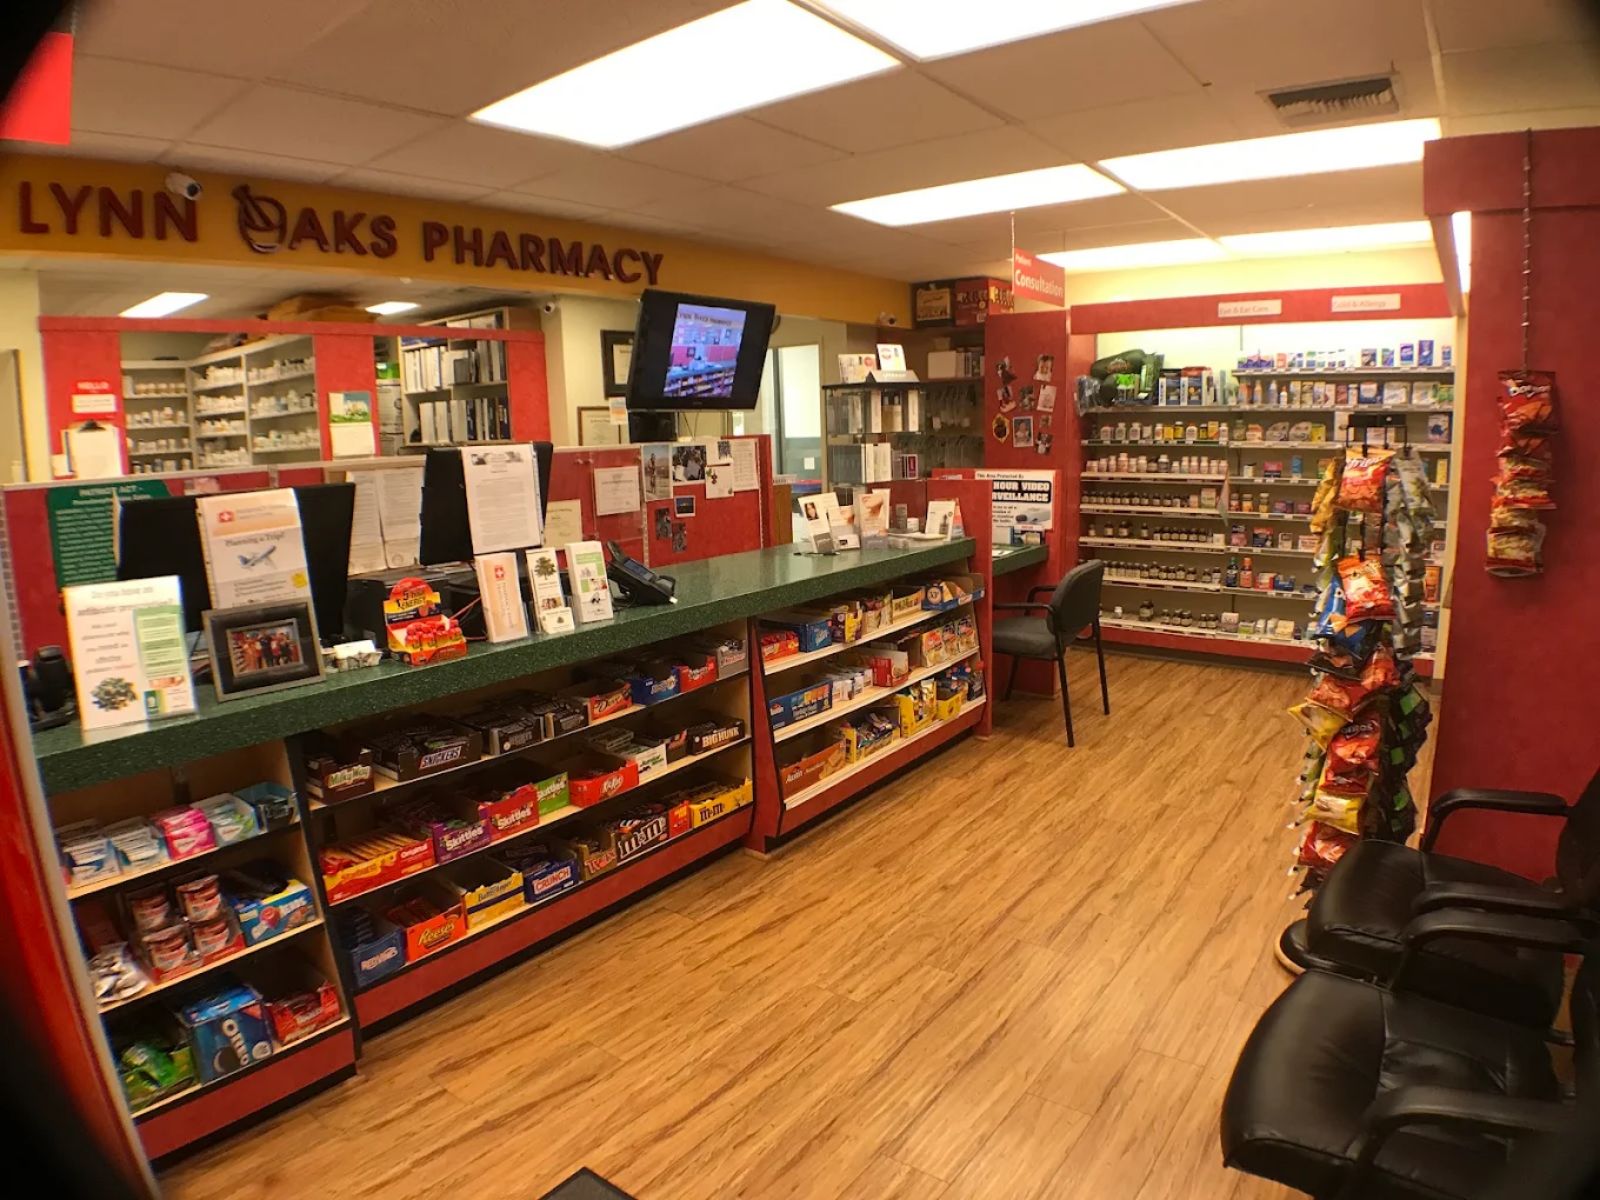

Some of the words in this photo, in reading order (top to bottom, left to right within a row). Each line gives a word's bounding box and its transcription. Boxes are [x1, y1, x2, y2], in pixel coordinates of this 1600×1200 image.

[18, 180, 199, 243] LYNN
[421, 220, 665, 286] PHARMACY
[1015, 269, 1064, 298] Consultation
[1021, 481, 1050, 491] VIDEO
[702, 733, 719, 748] BIG
[718, 727, 740, 743] HUNK
[422, 746, 462, 768] SNICKERS
[497, 805, 532, 827] Skittles
[445, 826, 484, 851] Skittles
[535, 867, 571, 893] CRUNCH
